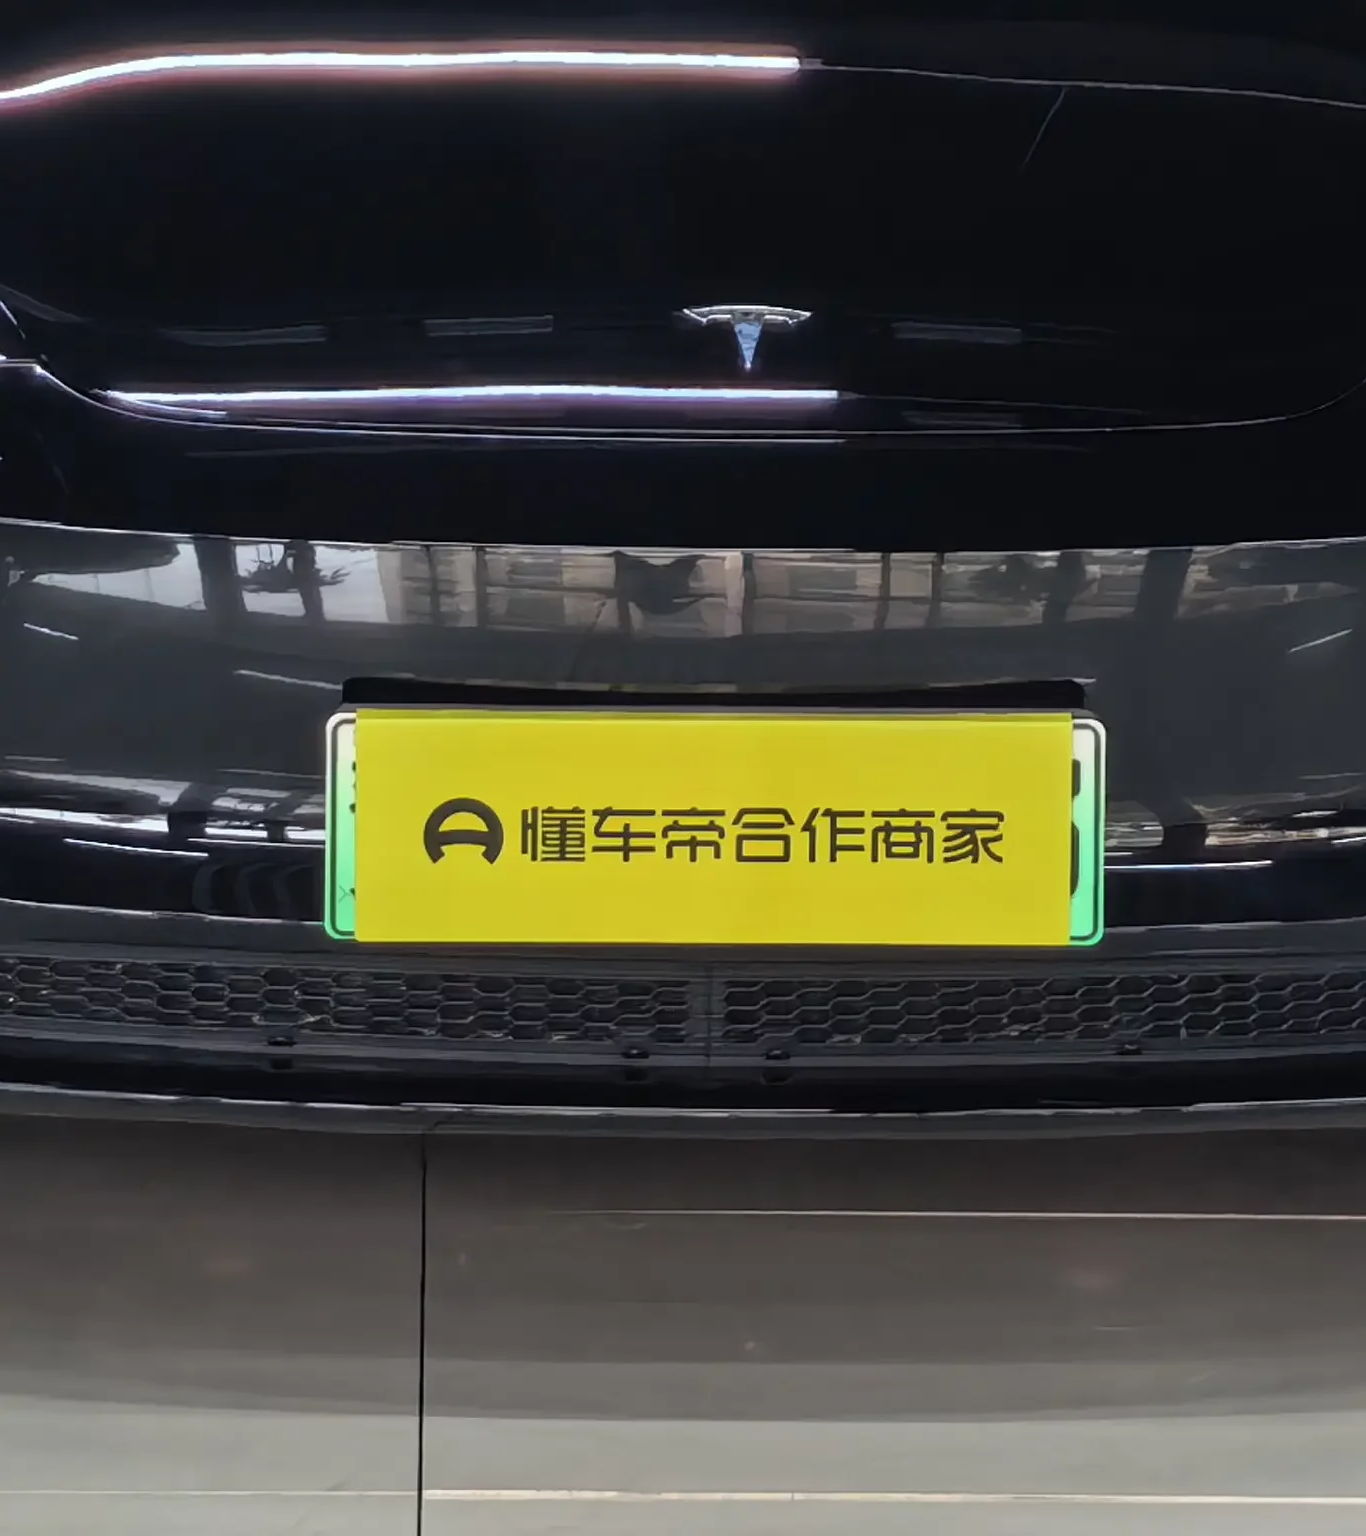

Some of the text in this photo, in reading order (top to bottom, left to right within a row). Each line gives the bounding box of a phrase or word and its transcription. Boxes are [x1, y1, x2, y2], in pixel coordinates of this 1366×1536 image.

[520, 805, 1005, 865] 懂车帝合作商家
